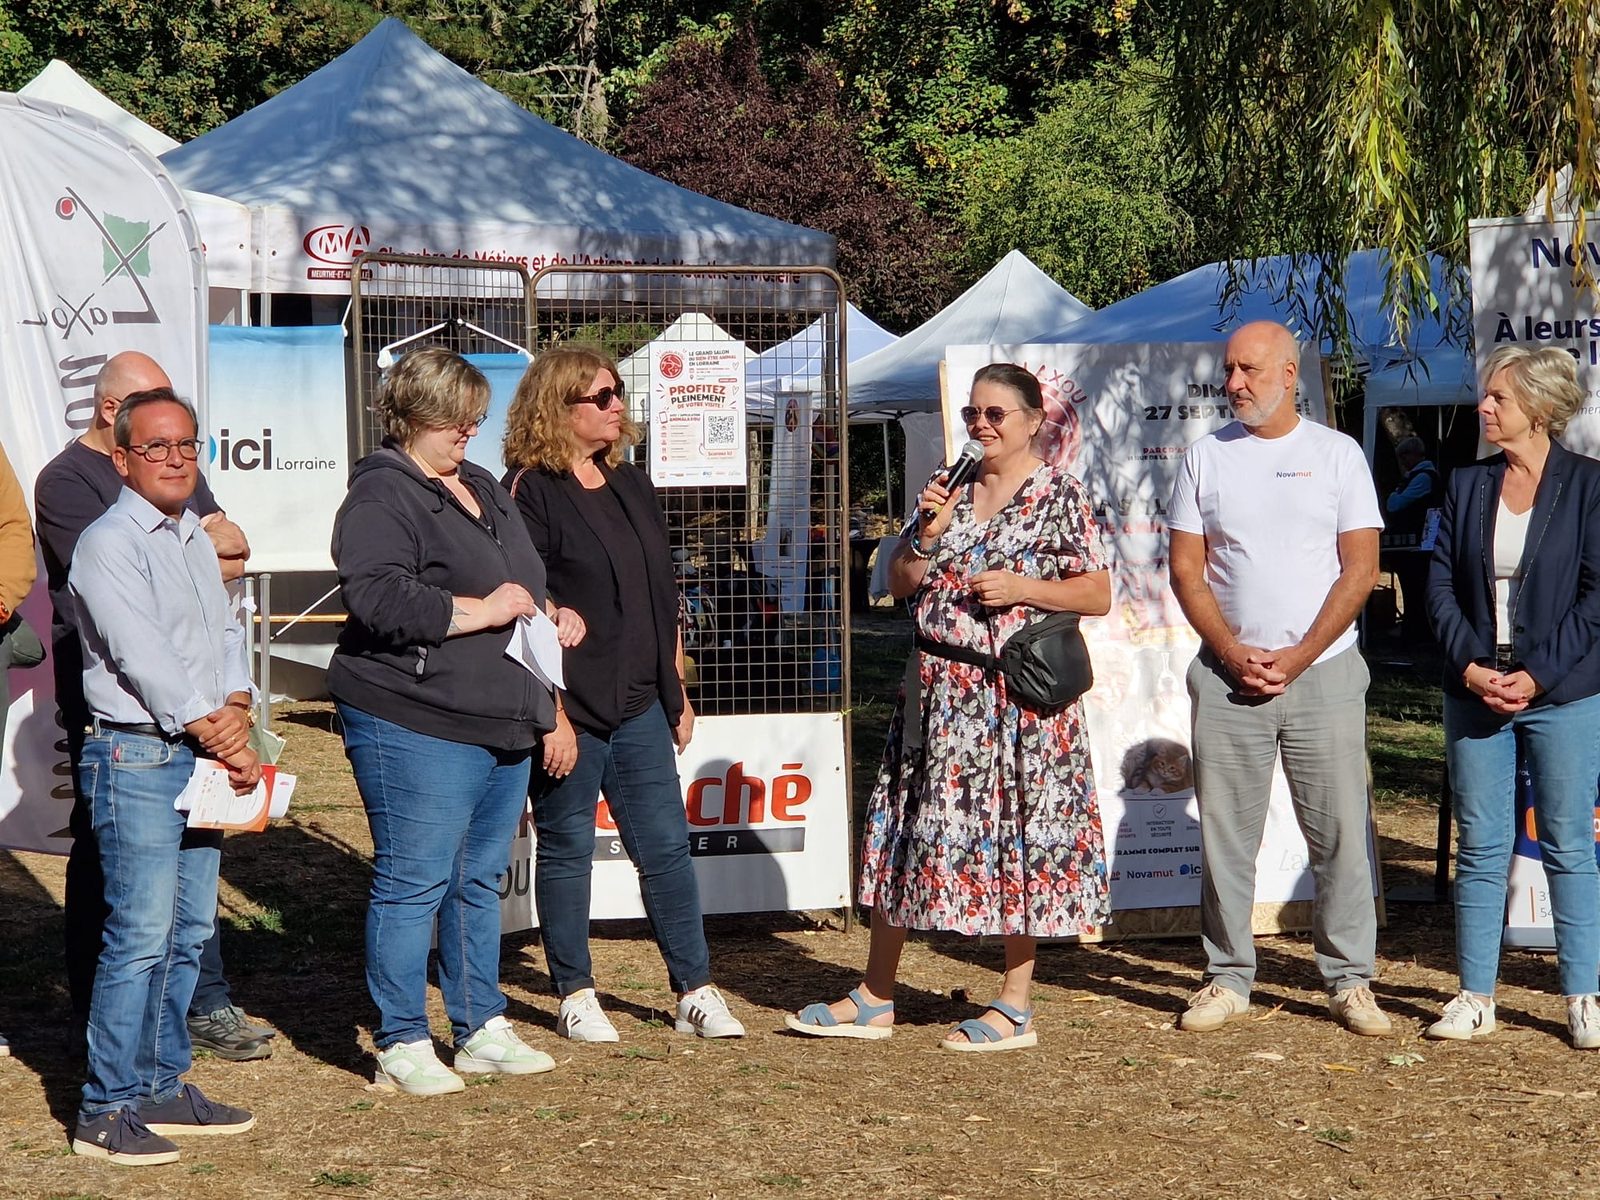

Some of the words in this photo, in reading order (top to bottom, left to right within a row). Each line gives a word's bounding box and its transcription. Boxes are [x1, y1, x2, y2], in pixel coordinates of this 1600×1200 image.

[1495, 312, 1517, 342] À
[1525, 315, 1600, 341] leurs
[669, 385, 726, 396] PROFITEZ
[1188, 384, 1227, 398] DIM
[671, 394, 726, 404] PLEINEMENT
[1145, 405, 1172, 420] 27
[220, 428, 272, 470] ici
[276, 457, 336, 470] Lorraine
[1148, 846, 1184, 854] COMPLET
[1127, 870, 1175, 879] Novamut
